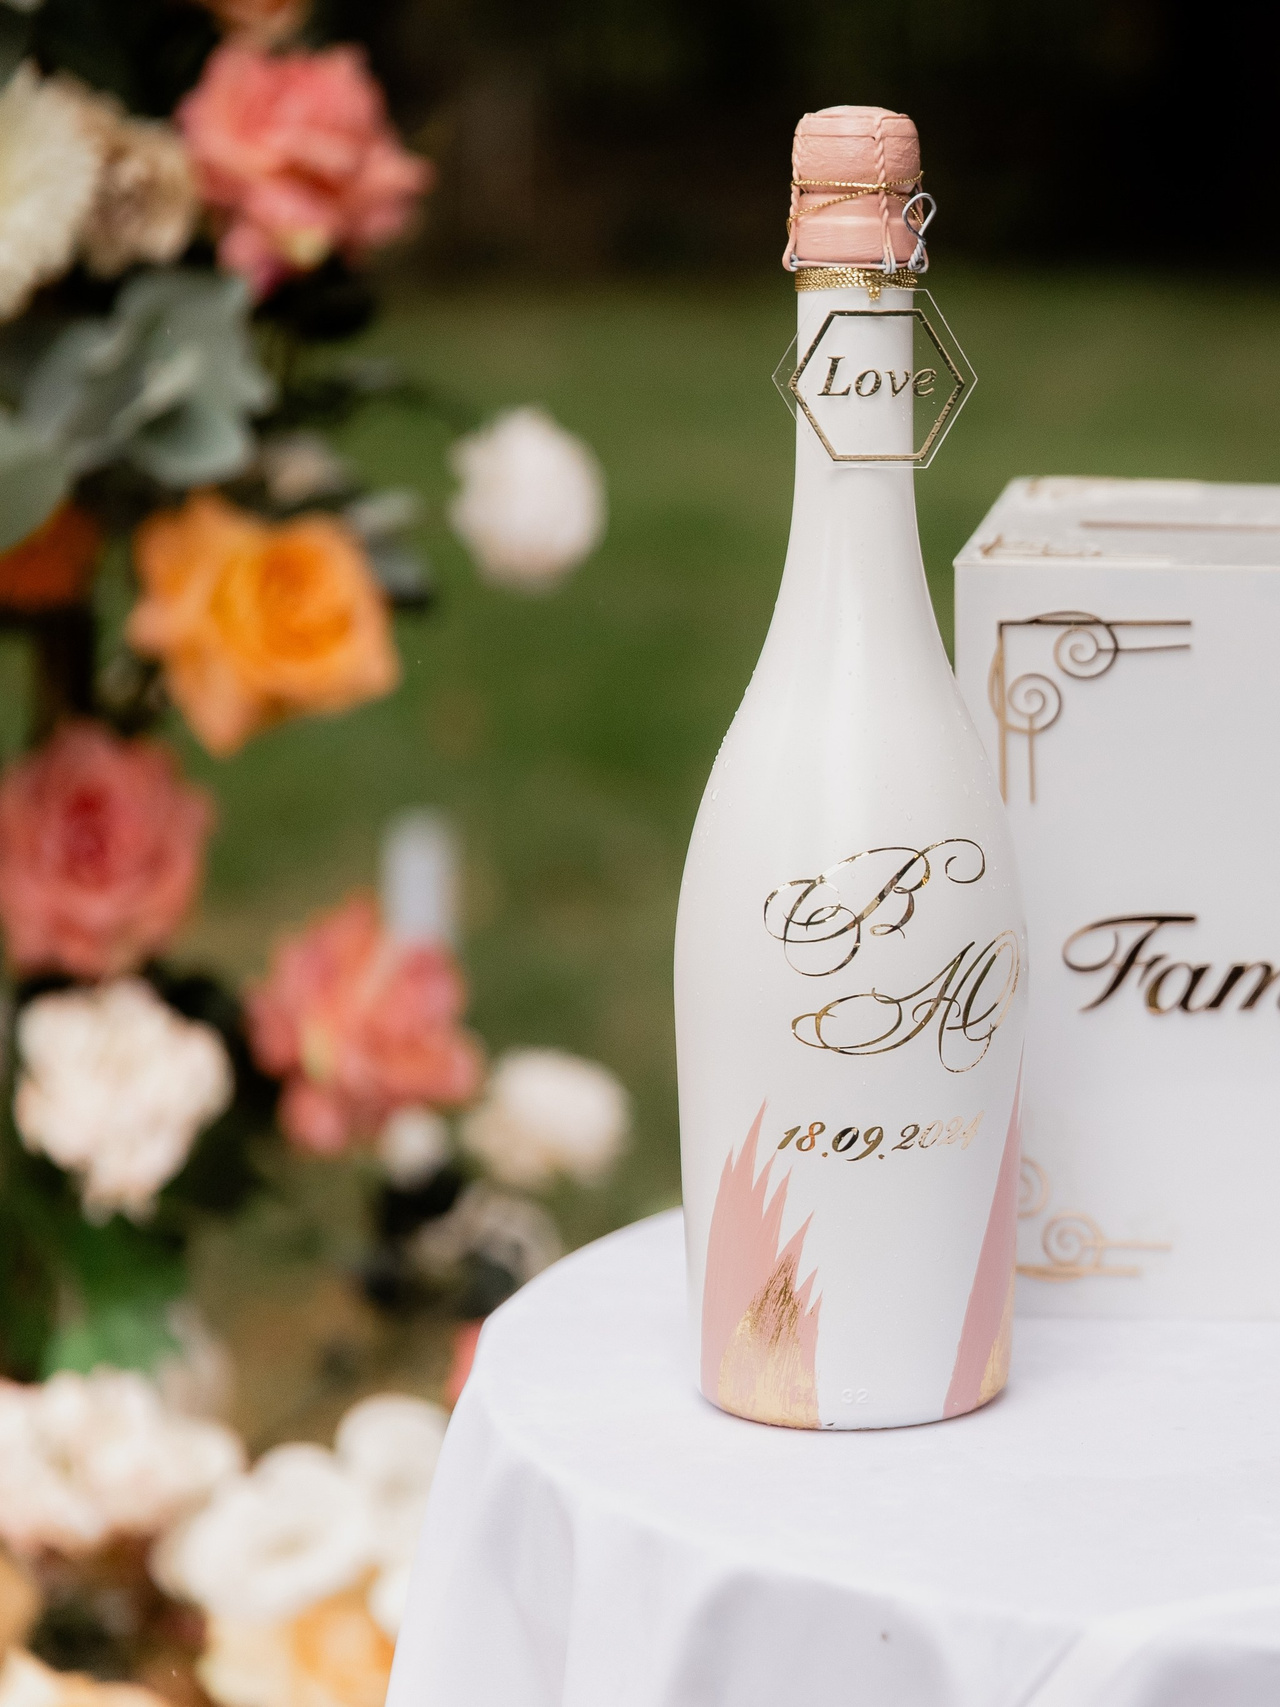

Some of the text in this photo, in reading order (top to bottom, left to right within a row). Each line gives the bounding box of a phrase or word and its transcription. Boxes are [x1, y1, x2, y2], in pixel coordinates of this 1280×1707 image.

[817, 355, 937, 397] Love
[777, 1110, 985, 1161] 18.09.2024
[841, 1388, 869, 1405] 32
